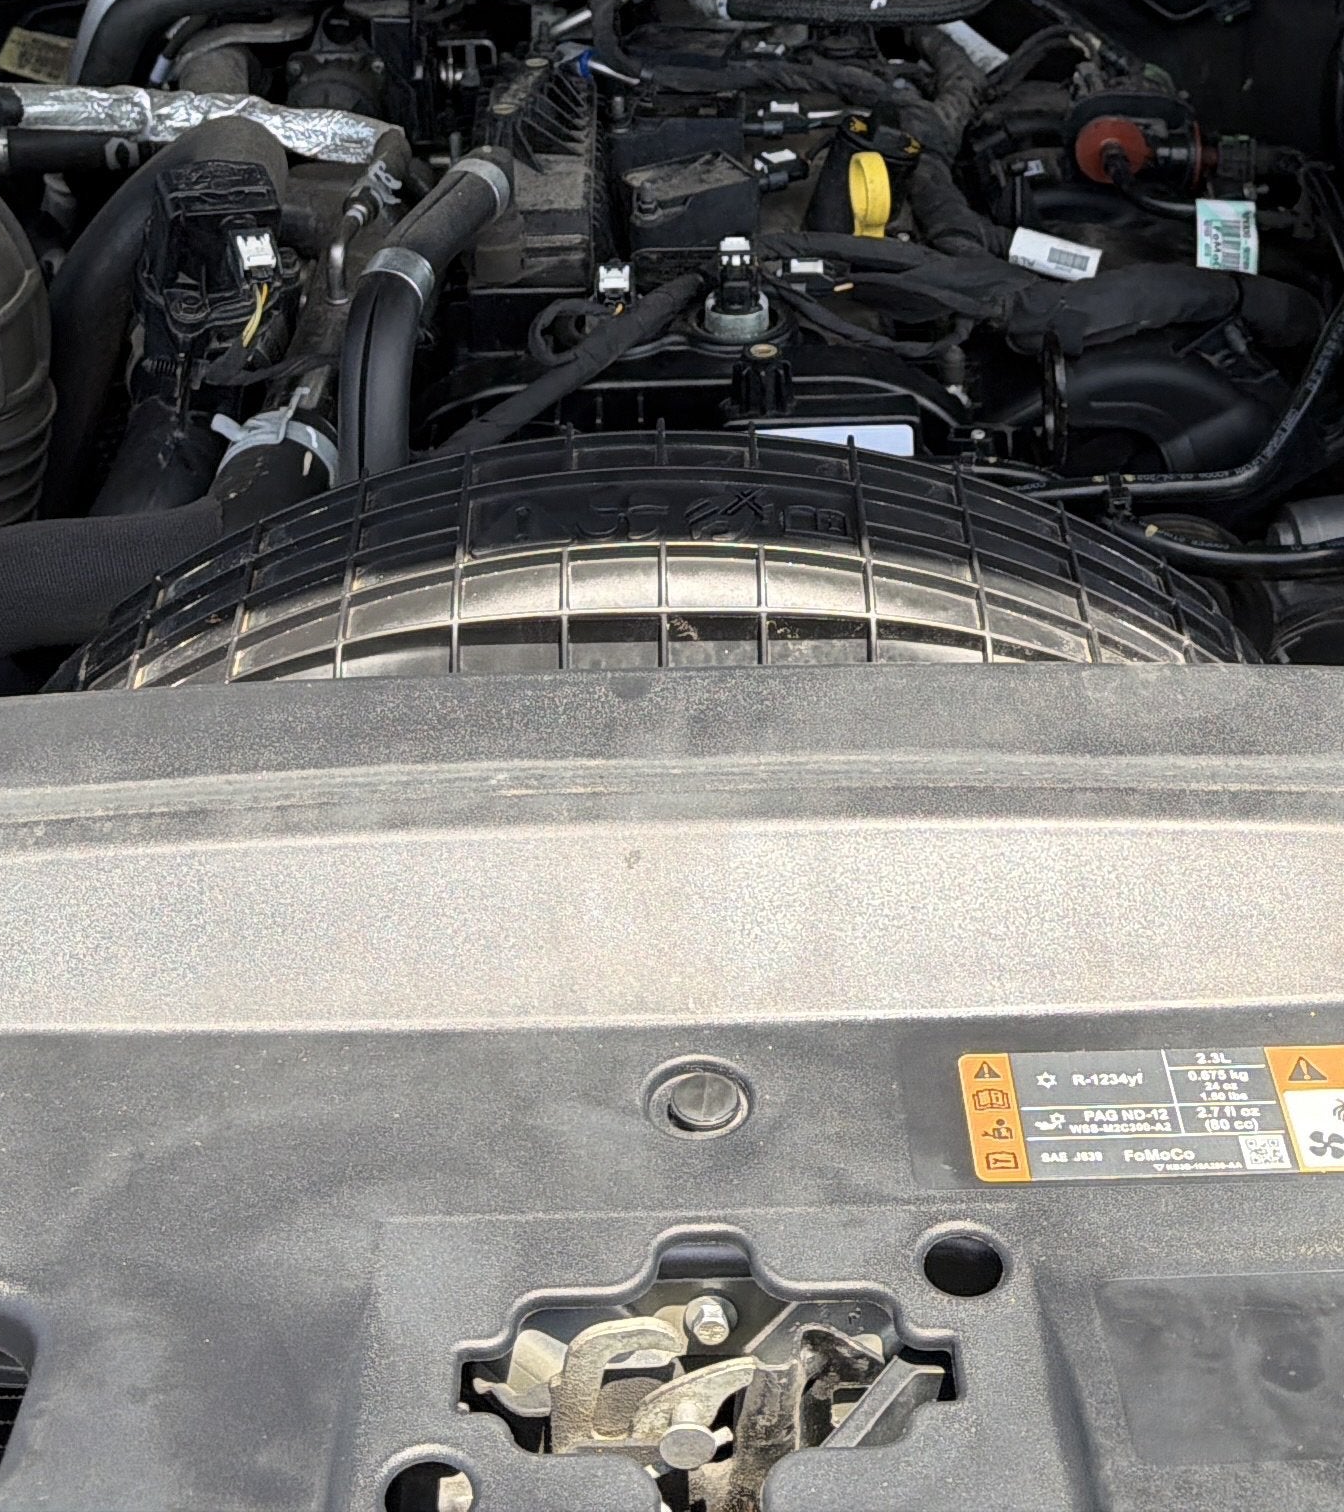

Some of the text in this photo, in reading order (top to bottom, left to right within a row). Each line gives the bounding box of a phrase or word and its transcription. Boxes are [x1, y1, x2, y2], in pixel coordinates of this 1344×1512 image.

[1195, 1052, 1232, 1064] 2.3L
[1072, 1072, 1144, 1087] R-1234yf
[1187, 1069, 1249, 1082] 0.675 kg
[1222, 1082, 1239, 1091] oz
[1083, 1108, 1170, 1122] PAG ND-12
[1196, 1106, 1220, 1119] 2.7
[1240, 1107, 1261, 1117] oz
[1233, 1118, 1259, 1132] cc)
[1040, 1151, 1068, 1163] SAE
[1123, 1147, 1196, 1162] FoMoCo
